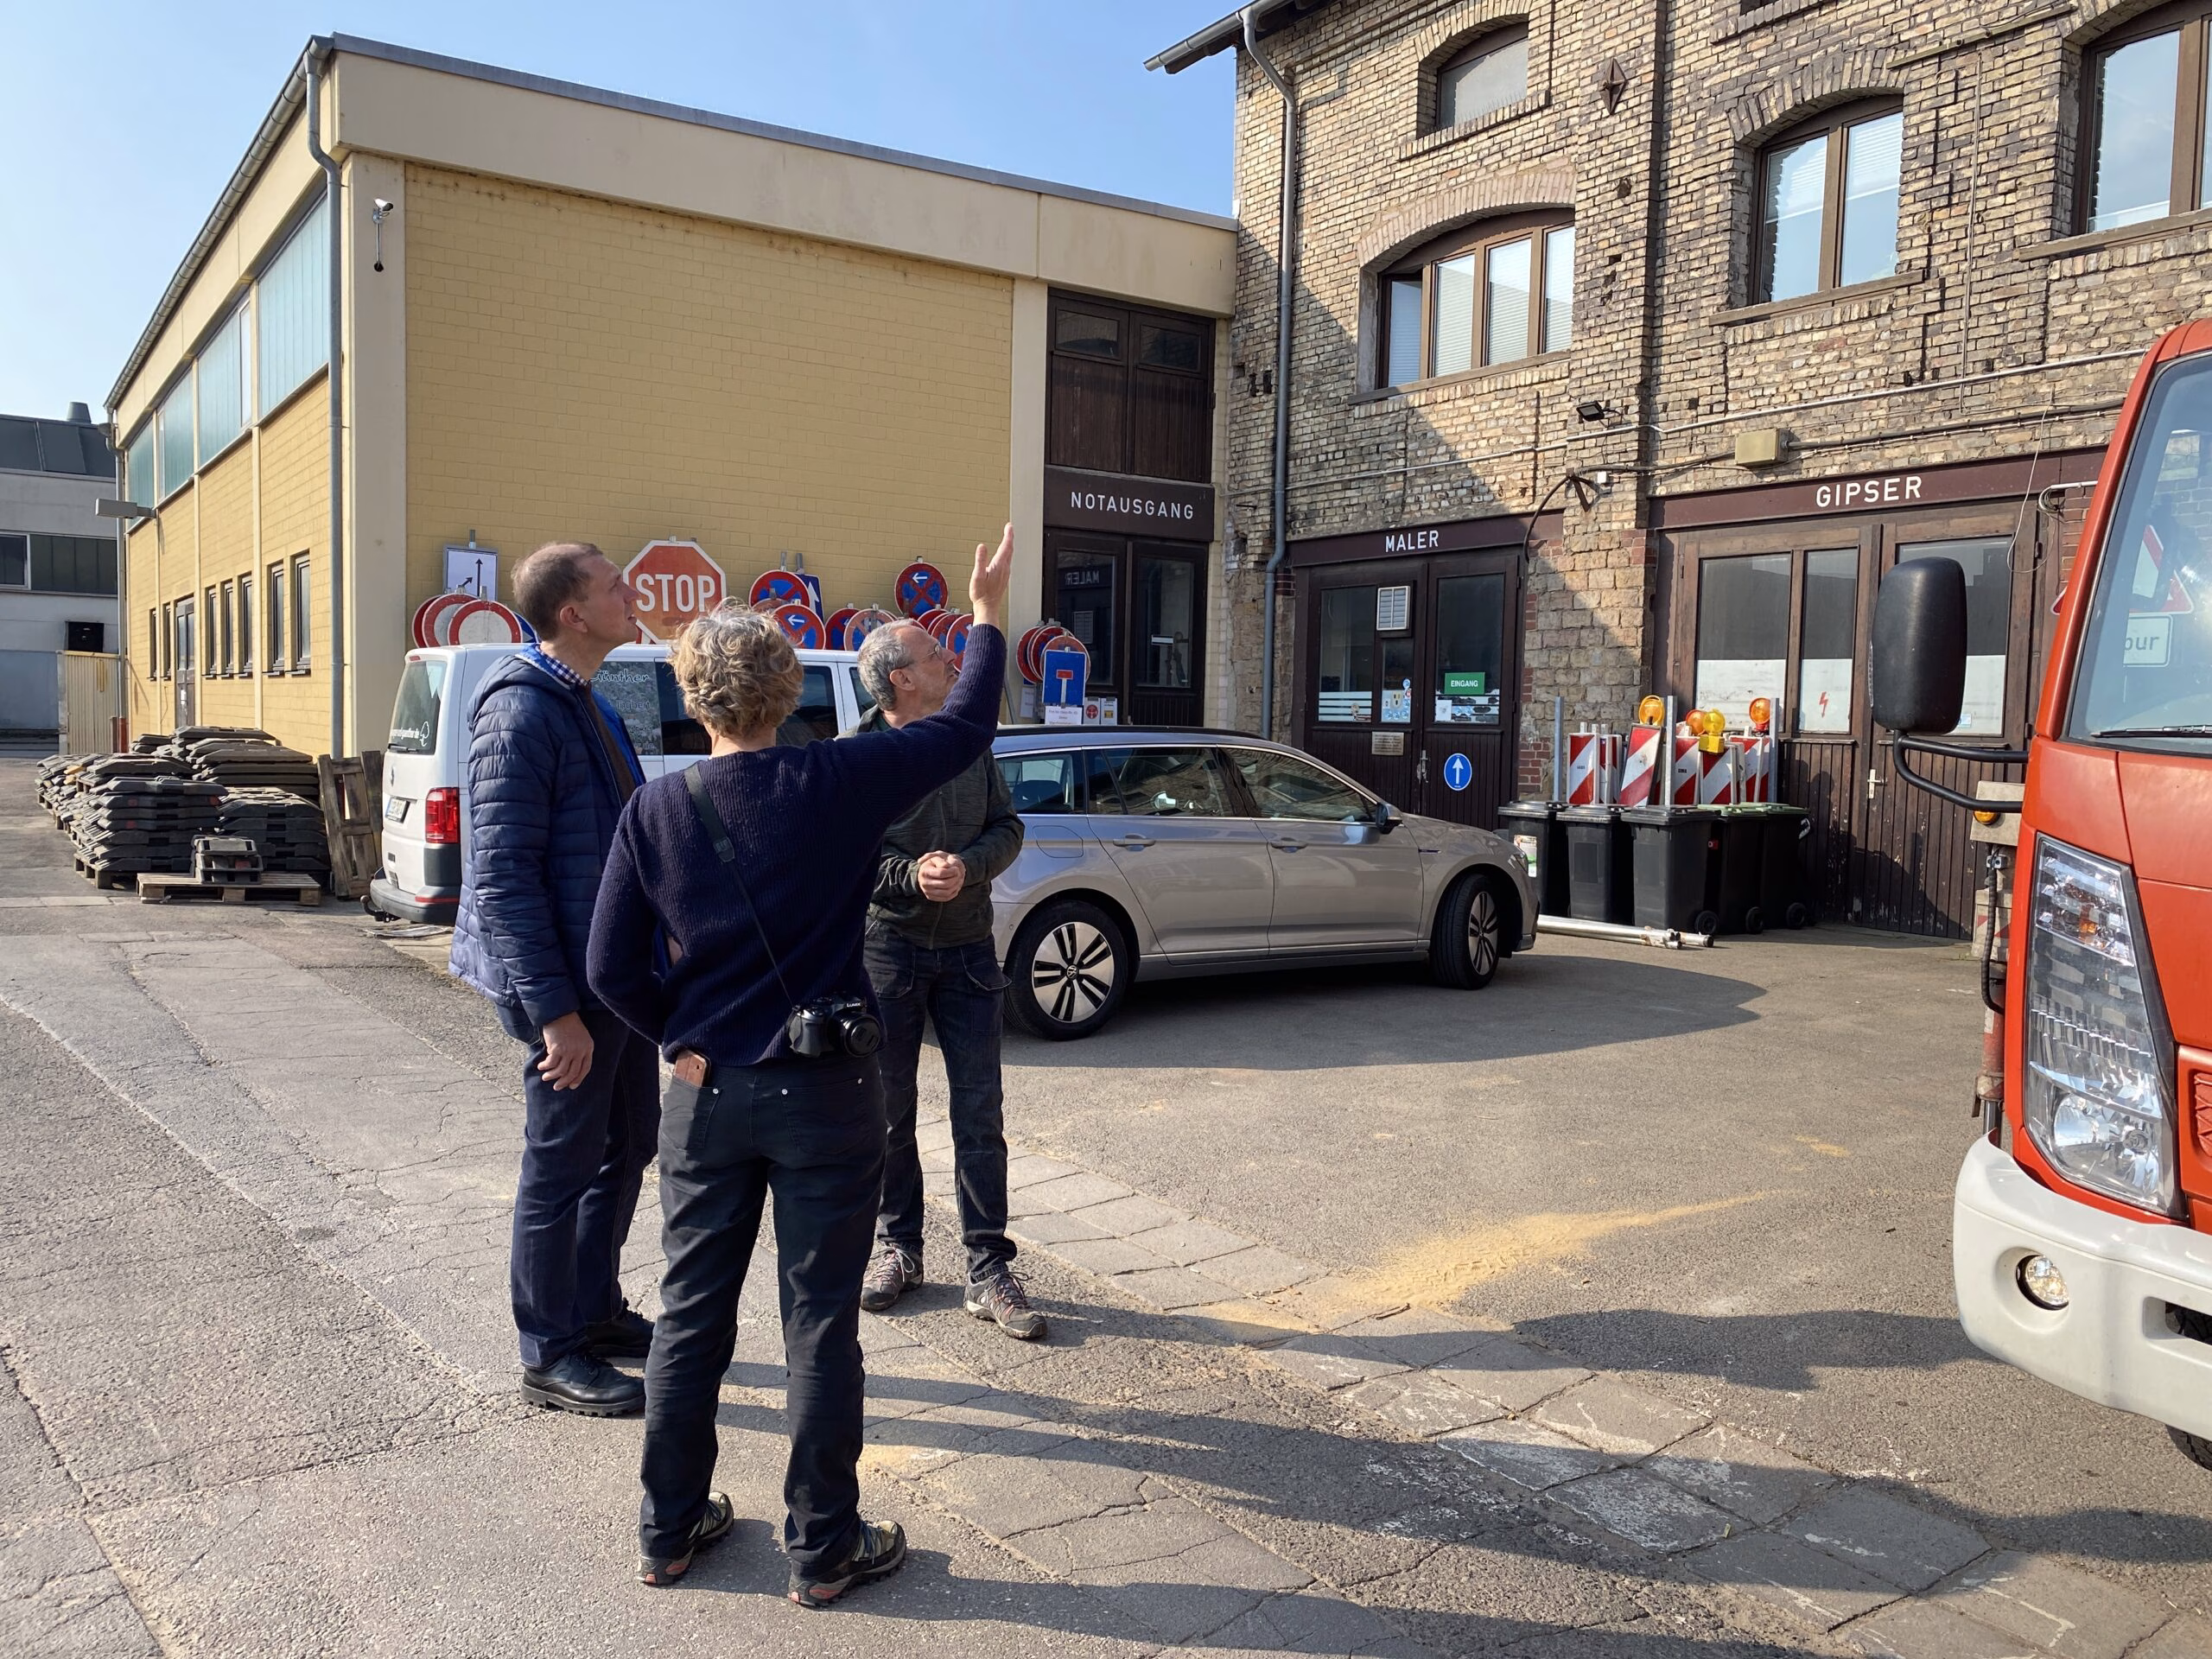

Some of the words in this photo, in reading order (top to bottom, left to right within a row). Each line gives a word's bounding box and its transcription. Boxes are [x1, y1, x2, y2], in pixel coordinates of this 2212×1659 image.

[1071, 491, 1193, 519] NOTAUSGANG
[1815, 475, 1923, 508] GIPSER
[1385, 530, 1440, 553] MALER
[635, 573, 715, 613] STOP
[1450, 679, 1478, 688] EINGANG
